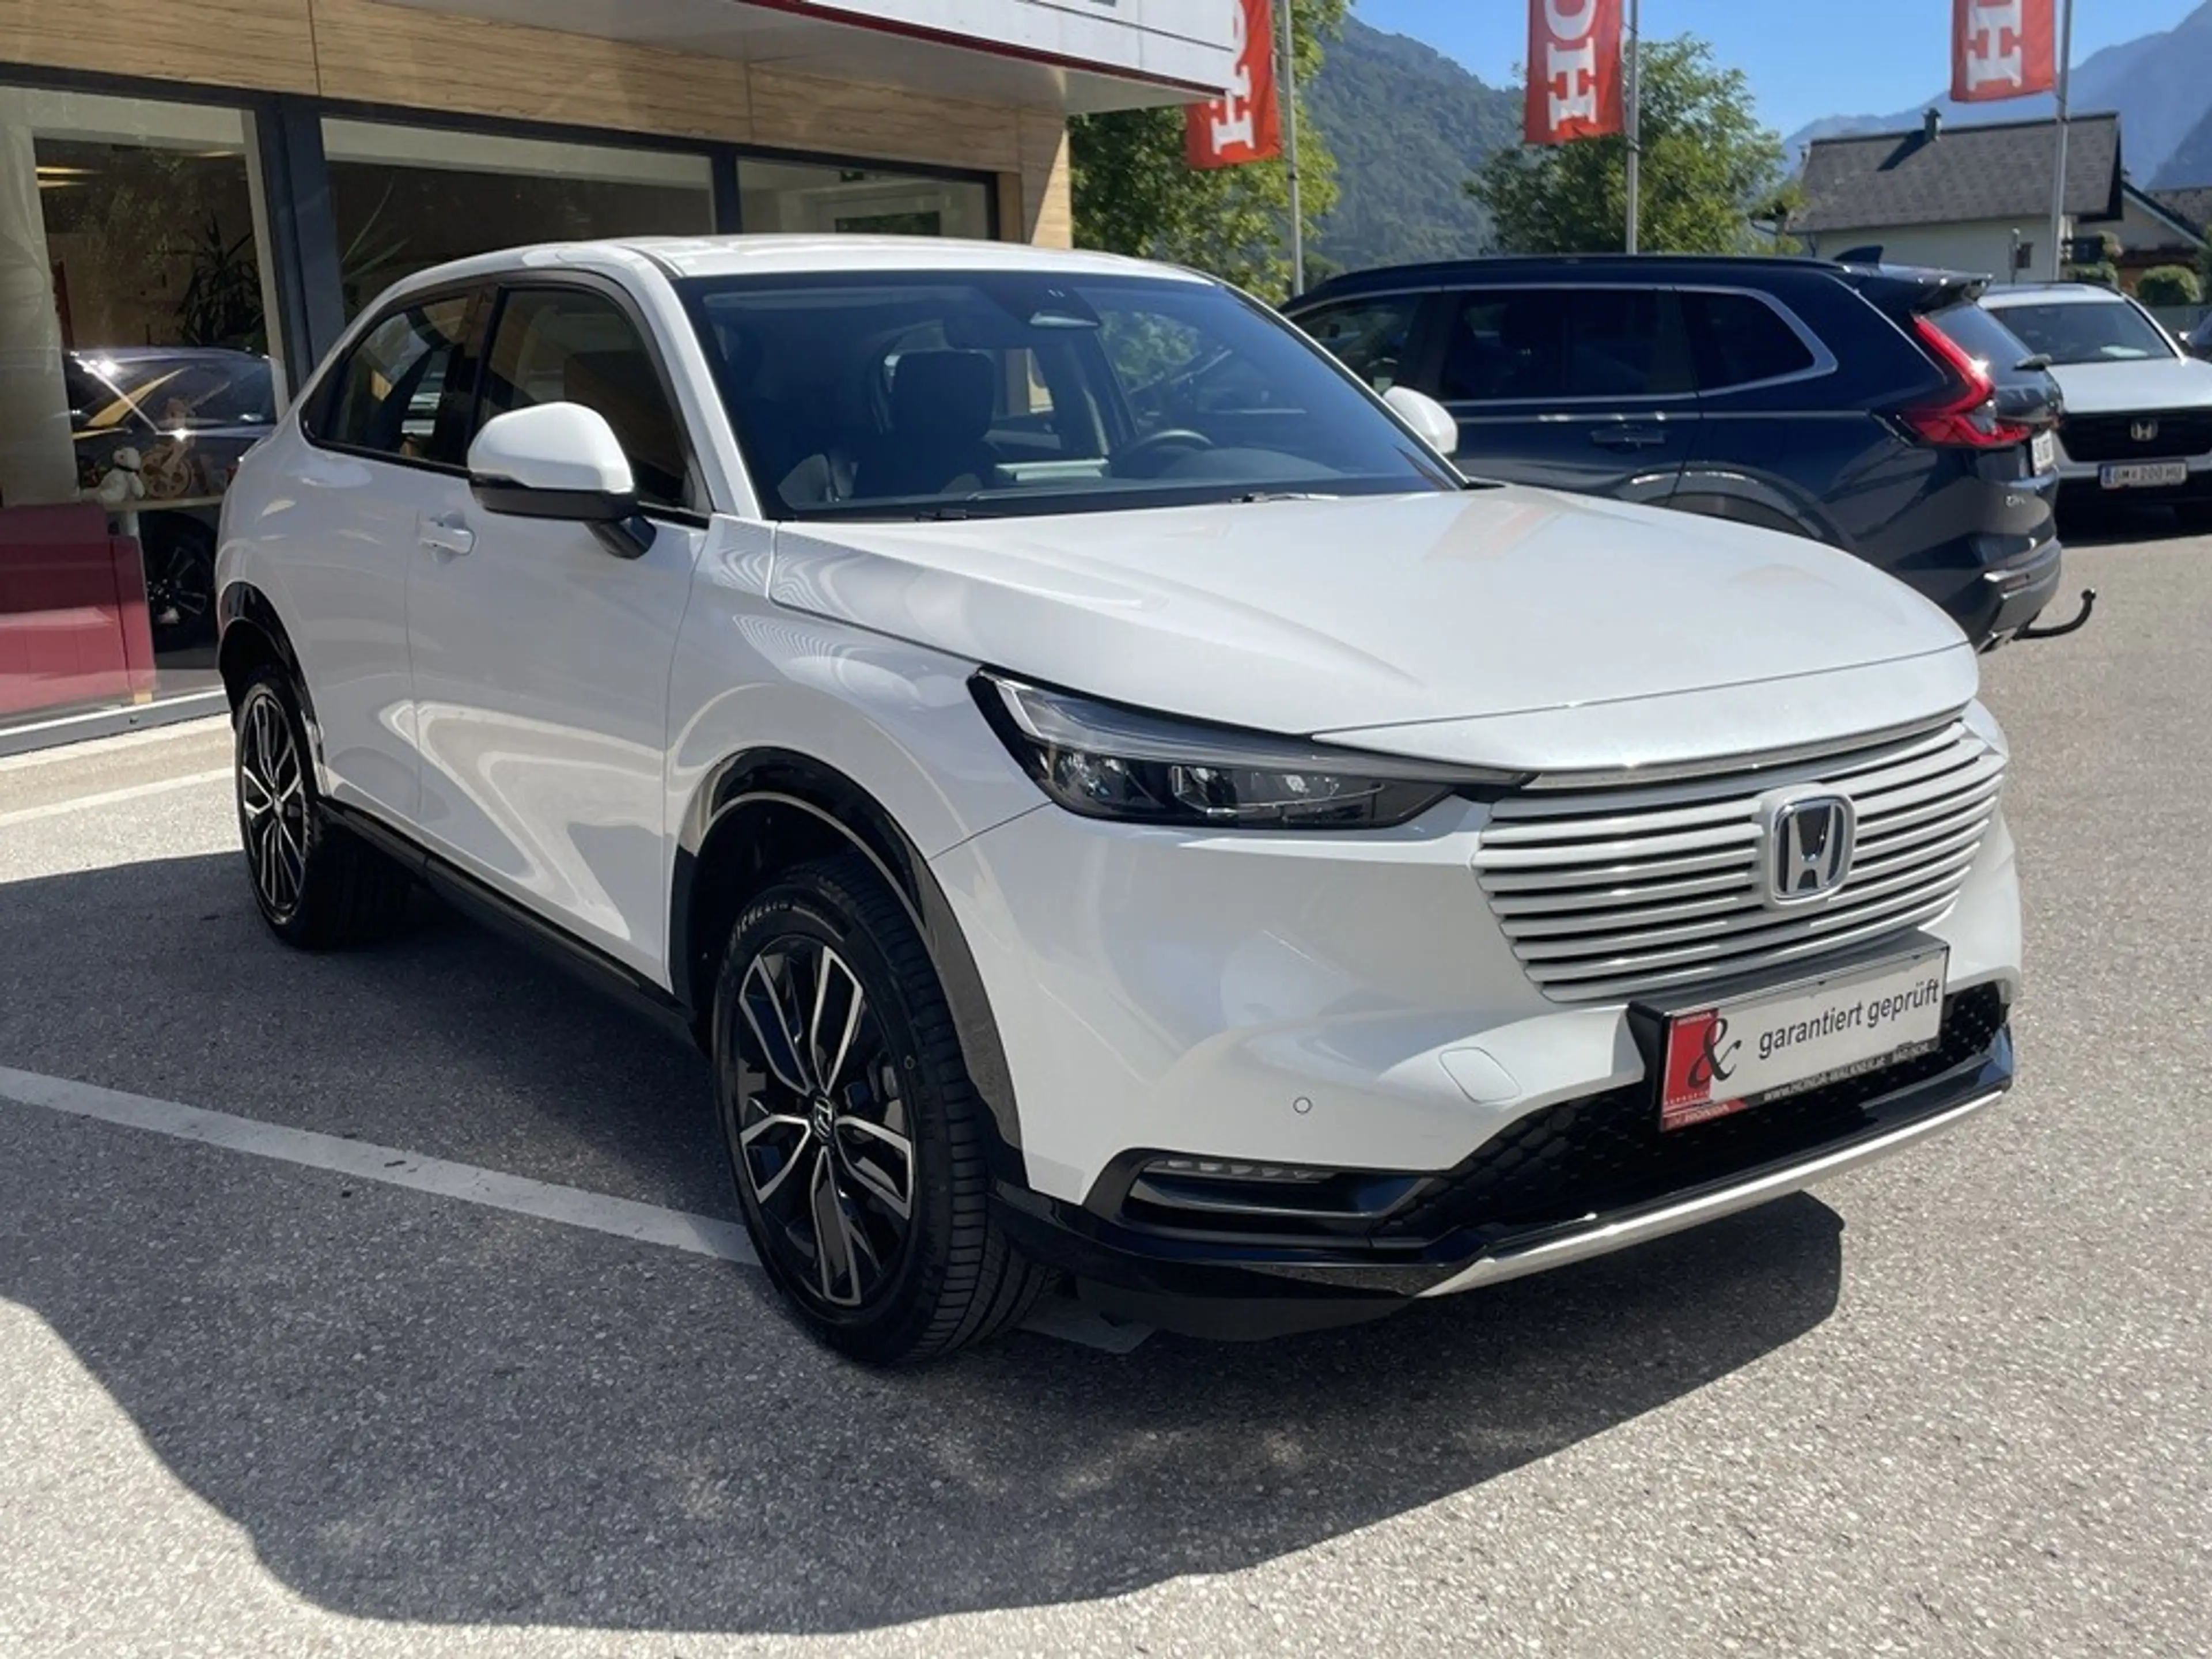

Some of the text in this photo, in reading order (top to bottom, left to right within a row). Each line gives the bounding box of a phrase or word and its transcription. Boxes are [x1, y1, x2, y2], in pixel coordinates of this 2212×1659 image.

[1687, 1017, 1742, 1088] &
[1759, 978, 1940, 1060] garantiert geprüft
